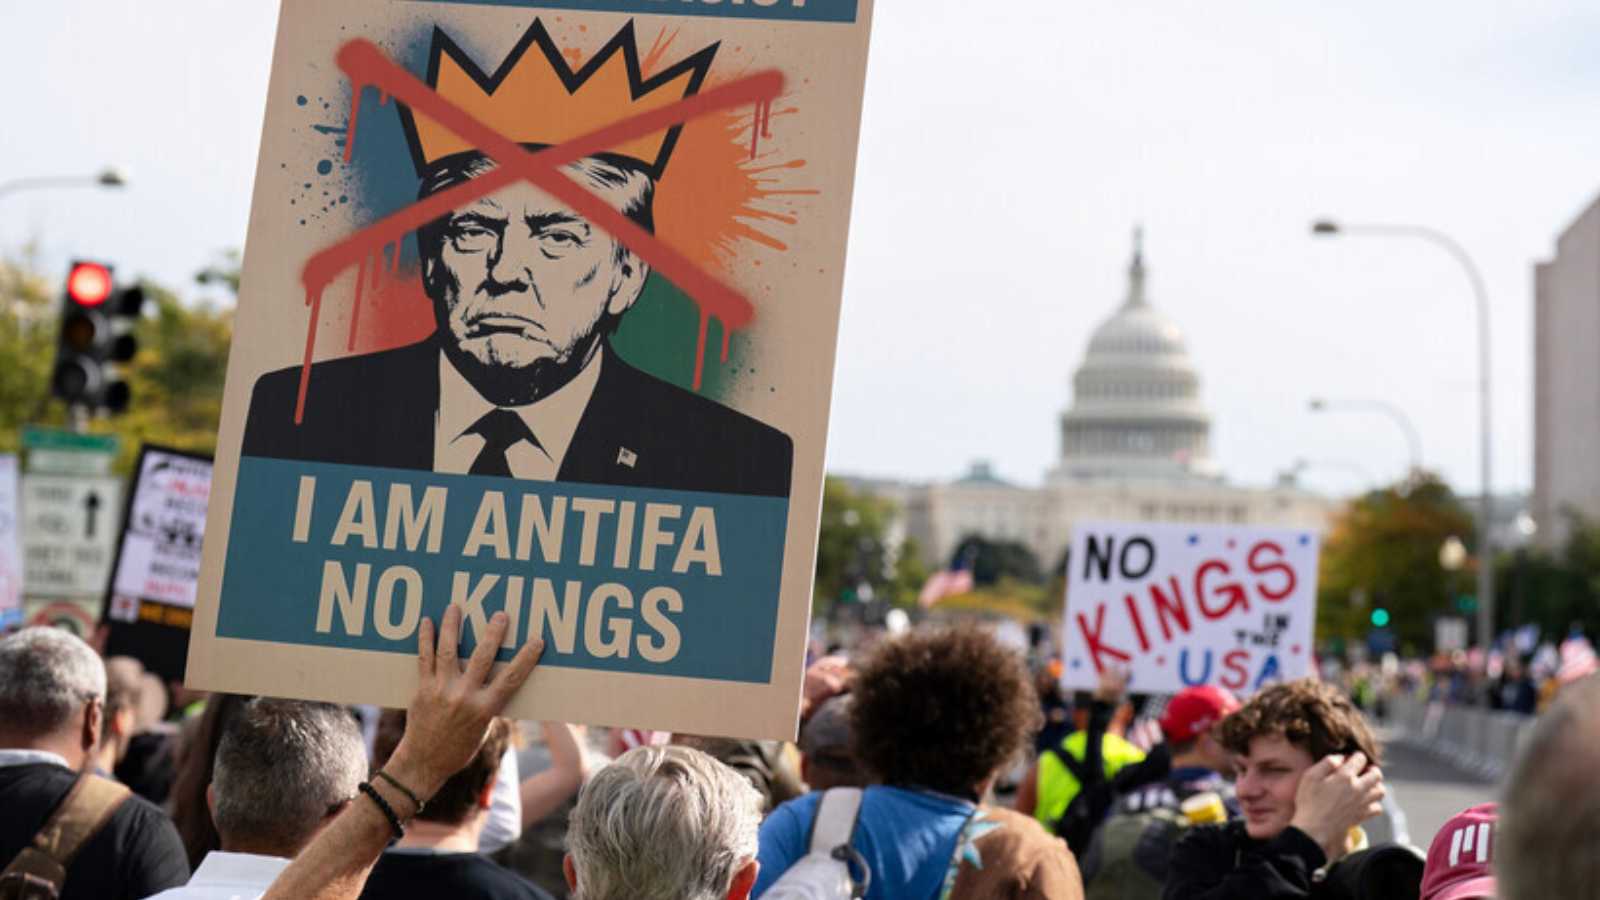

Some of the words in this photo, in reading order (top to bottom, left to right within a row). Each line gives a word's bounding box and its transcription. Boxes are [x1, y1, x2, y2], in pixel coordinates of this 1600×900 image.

[292, 475, 316, 542] I
[331, 479, 449, 554] AM
[462, 490, 723, 577] ANTIFA
[1083, 534, 1157, 582] NO
[315, 560, 424, 641] NO
[449, 570, 684, 664] KINGS
[1076, 540, 1297, 676] KINGS
[1263, 613, 1289, 630] IN
[1235, 630, 1280, 646] THE
[1180, 647, 1283, 690] USA
